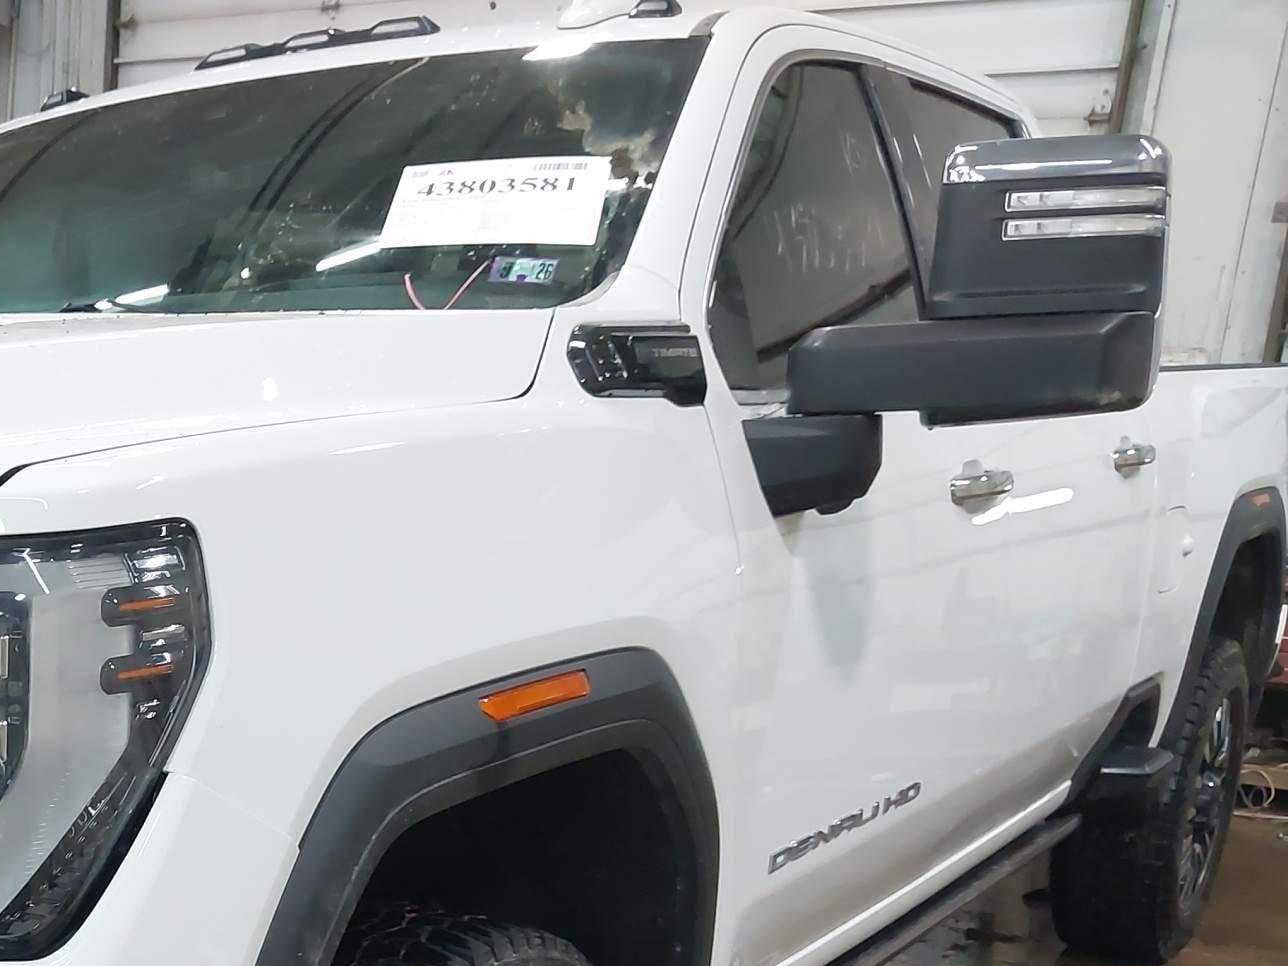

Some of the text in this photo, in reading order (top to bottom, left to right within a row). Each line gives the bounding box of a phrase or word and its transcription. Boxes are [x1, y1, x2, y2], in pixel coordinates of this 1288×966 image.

[417, 177, 576, 196] 43803581
[535, 262, 554, 280] 26
[767, 782, 921, 875] DENALI HD
